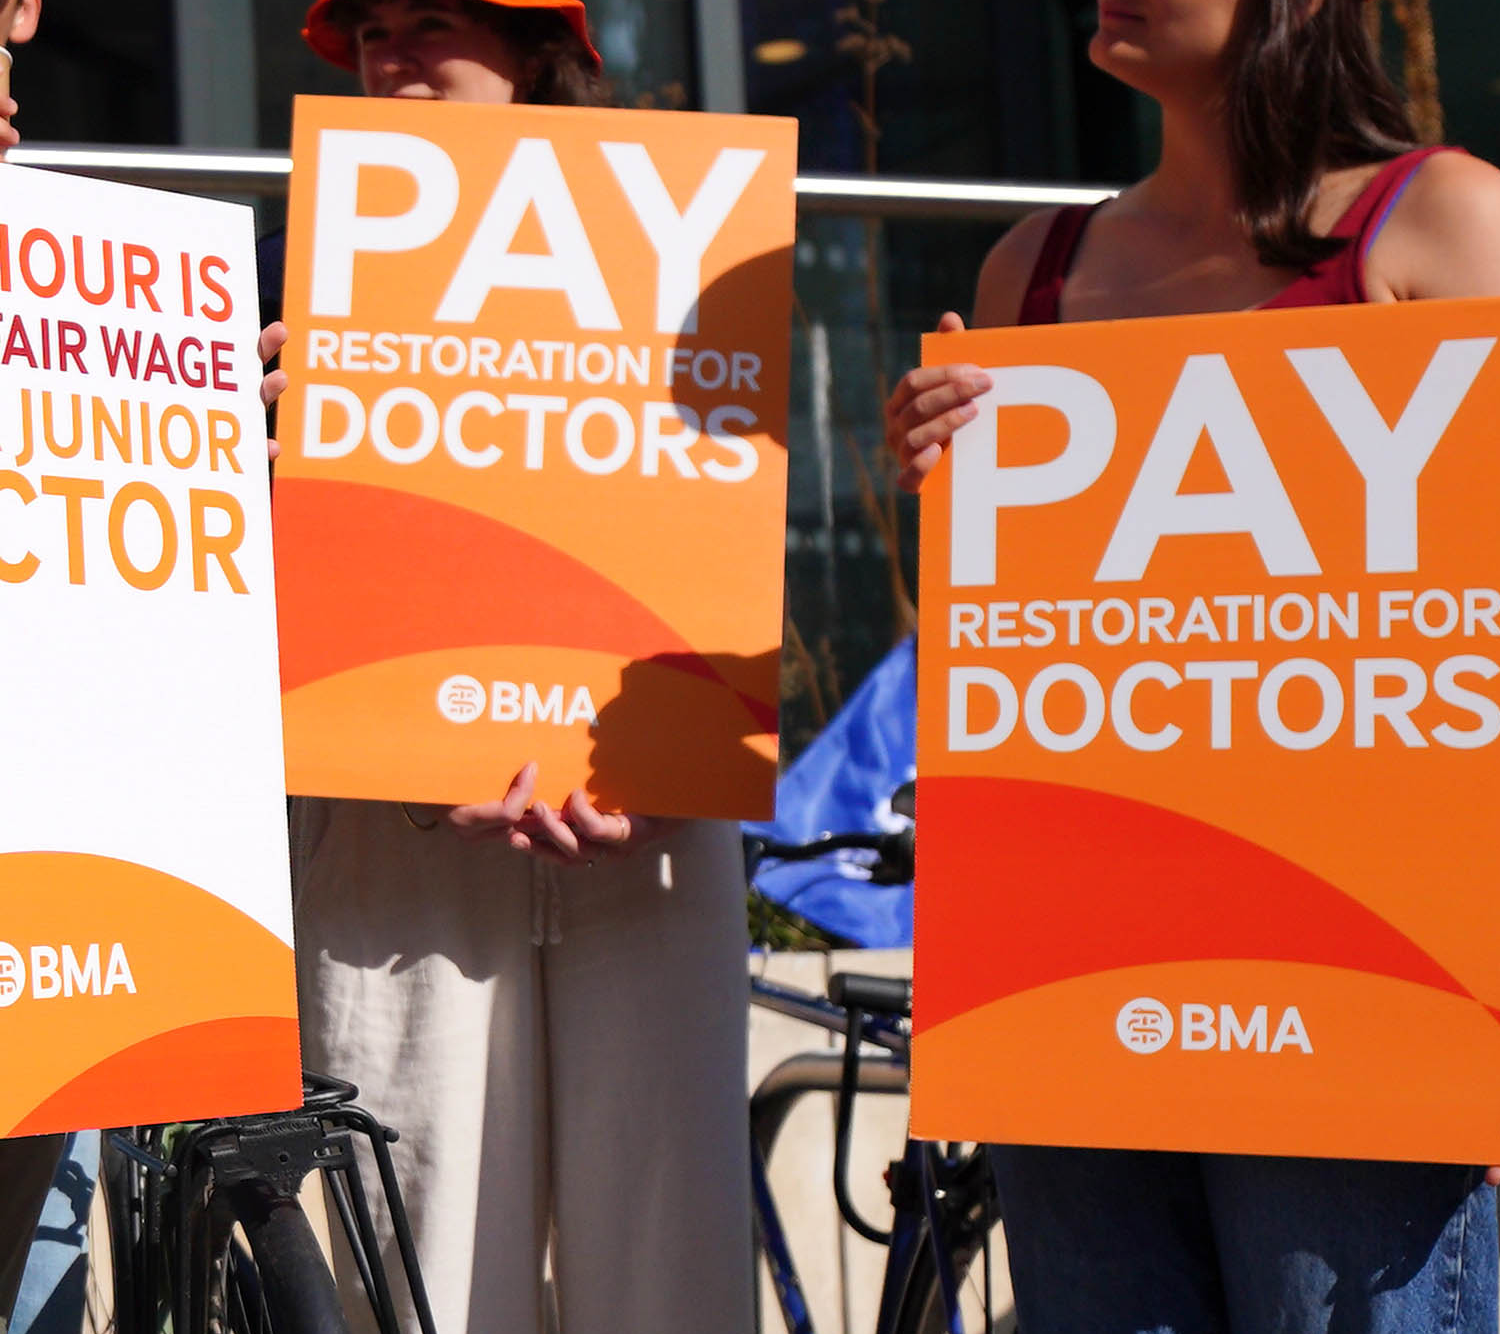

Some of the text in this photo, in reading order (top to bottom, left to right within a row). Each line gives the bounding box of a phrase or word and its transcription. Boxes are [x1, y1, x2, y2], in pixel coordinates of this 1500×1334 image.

[310, 129, 766, 334] PAY
[181, 251, 233, 323] IS
[102, 327, 237, 392] WAGE
[307, 330, 762, 392] RESTORATION FOR
[16, 392, 243, 475] JUNIOR
[303, 386, 759, 483] DOCTORS
[951, 337, 1498, 587] PAY
[949, 592, 1358, 649] RESTORATION
[491, 682, 598, 726] BMA
[31, 942, 136, 999] BMA
[1181, 1003, 1313, 1054] BMA
